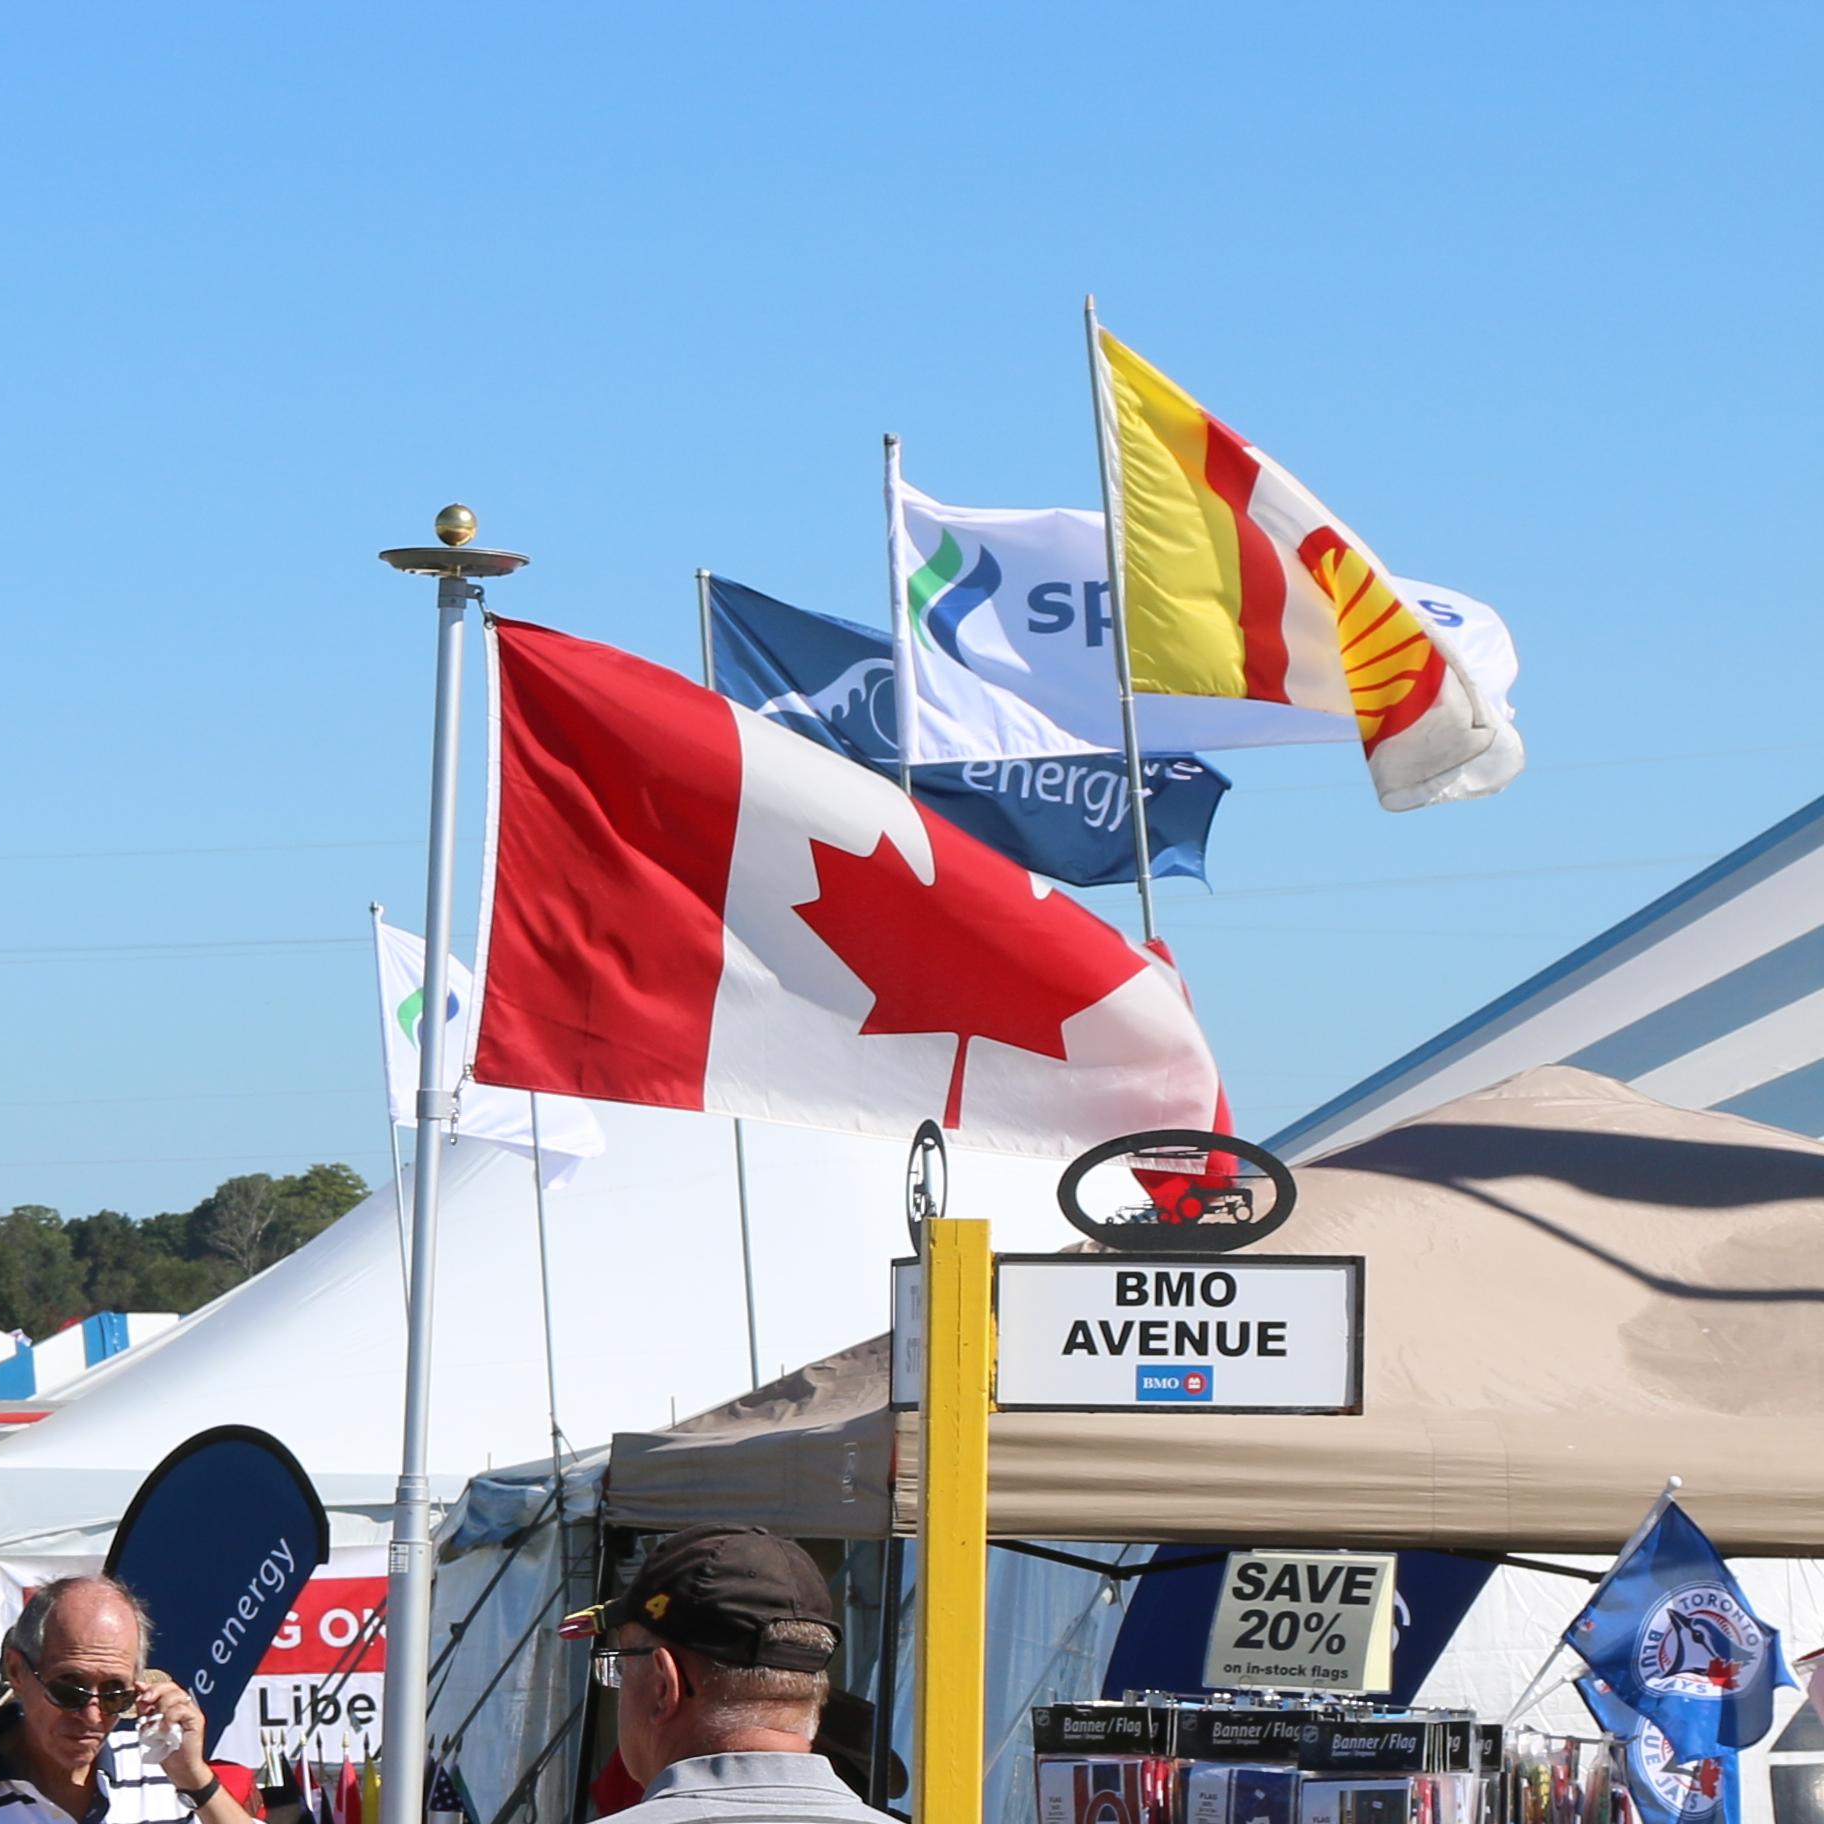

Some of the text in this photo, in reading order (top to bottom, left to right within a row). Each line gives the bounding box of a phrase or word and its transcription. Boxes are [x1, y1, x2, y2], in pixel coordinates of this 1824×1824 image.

[1115, 1271, 1237, 1307] BMO
[1061, 1320, 1288, 1357] AVENUE
[1143, 1377, 1179, 1390] BMO
[210, 1536, 300, 1666] energy
[1232, 1562, 1378, 1606] SAVE
[1233, 1609, 1346, 1655] 20%
[1680, 1593, 1759, 1647] TORONTO
[1223, 1662, 1349, 1682] on in-stock flags
[259, 1686, 376, 1728] Libe
[1063, 1717, 1107, 1733] Banner
[1115, 1717, 1142, 1736] Flag
[1212, 1722, 1261, 1738] Banner
[1331, 1734, 1379, 1751] Banner
[1388, 1734, 1417, 1753] Flag
